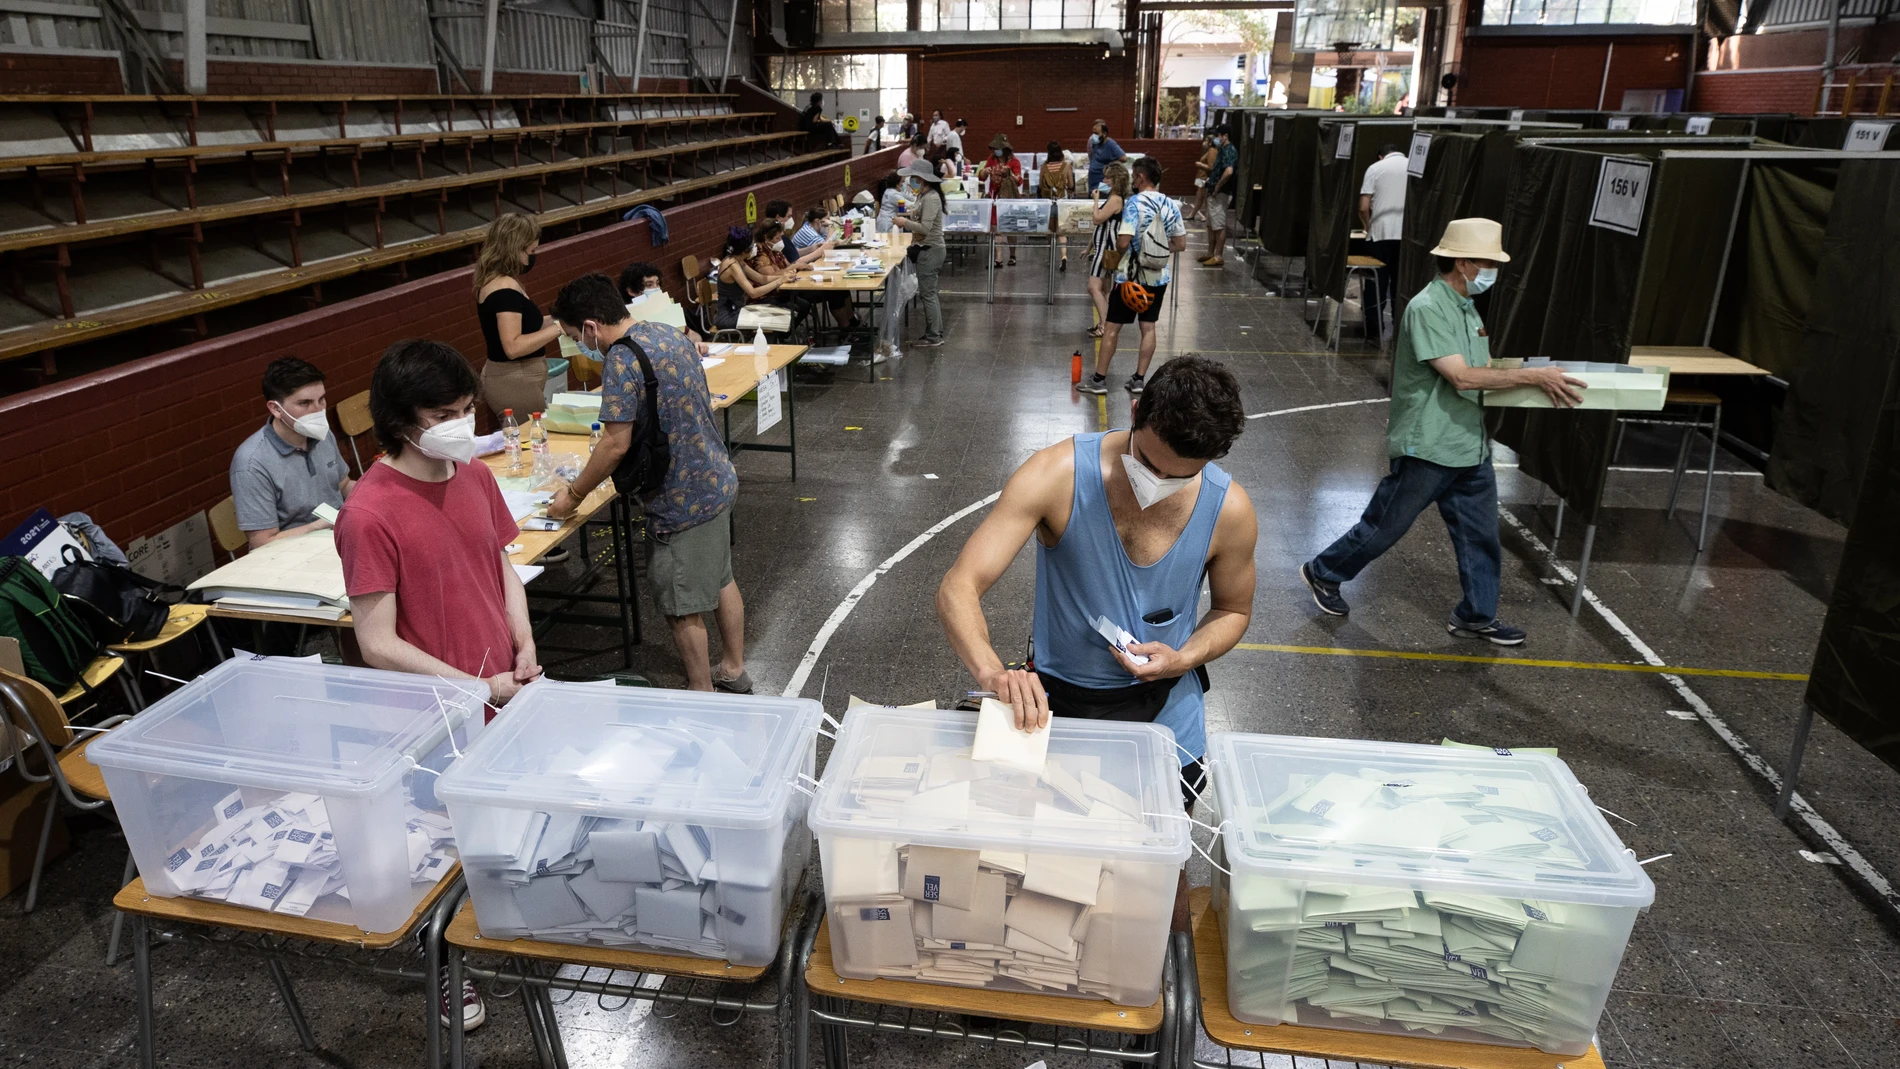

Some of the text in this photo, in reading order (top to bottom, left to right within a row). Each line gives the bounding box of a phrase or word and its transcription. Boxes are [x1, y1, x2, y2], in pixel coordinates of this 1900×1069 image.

[1855, 130, 1881, 141] 151 V
[1611, 177, 1639, 197] 156 V
[20, 525, 40, 545] 2021
[128, 543, 149, 562] CORE
[289, 829, 300, 840] SER
[297, 831, 308, 841] VEL
[264, 885, 275, 898] SER
[926, 883, 938, 892] VEL
[925, 891, 938, 899] SER
[878, 909, 888, 920] SER
